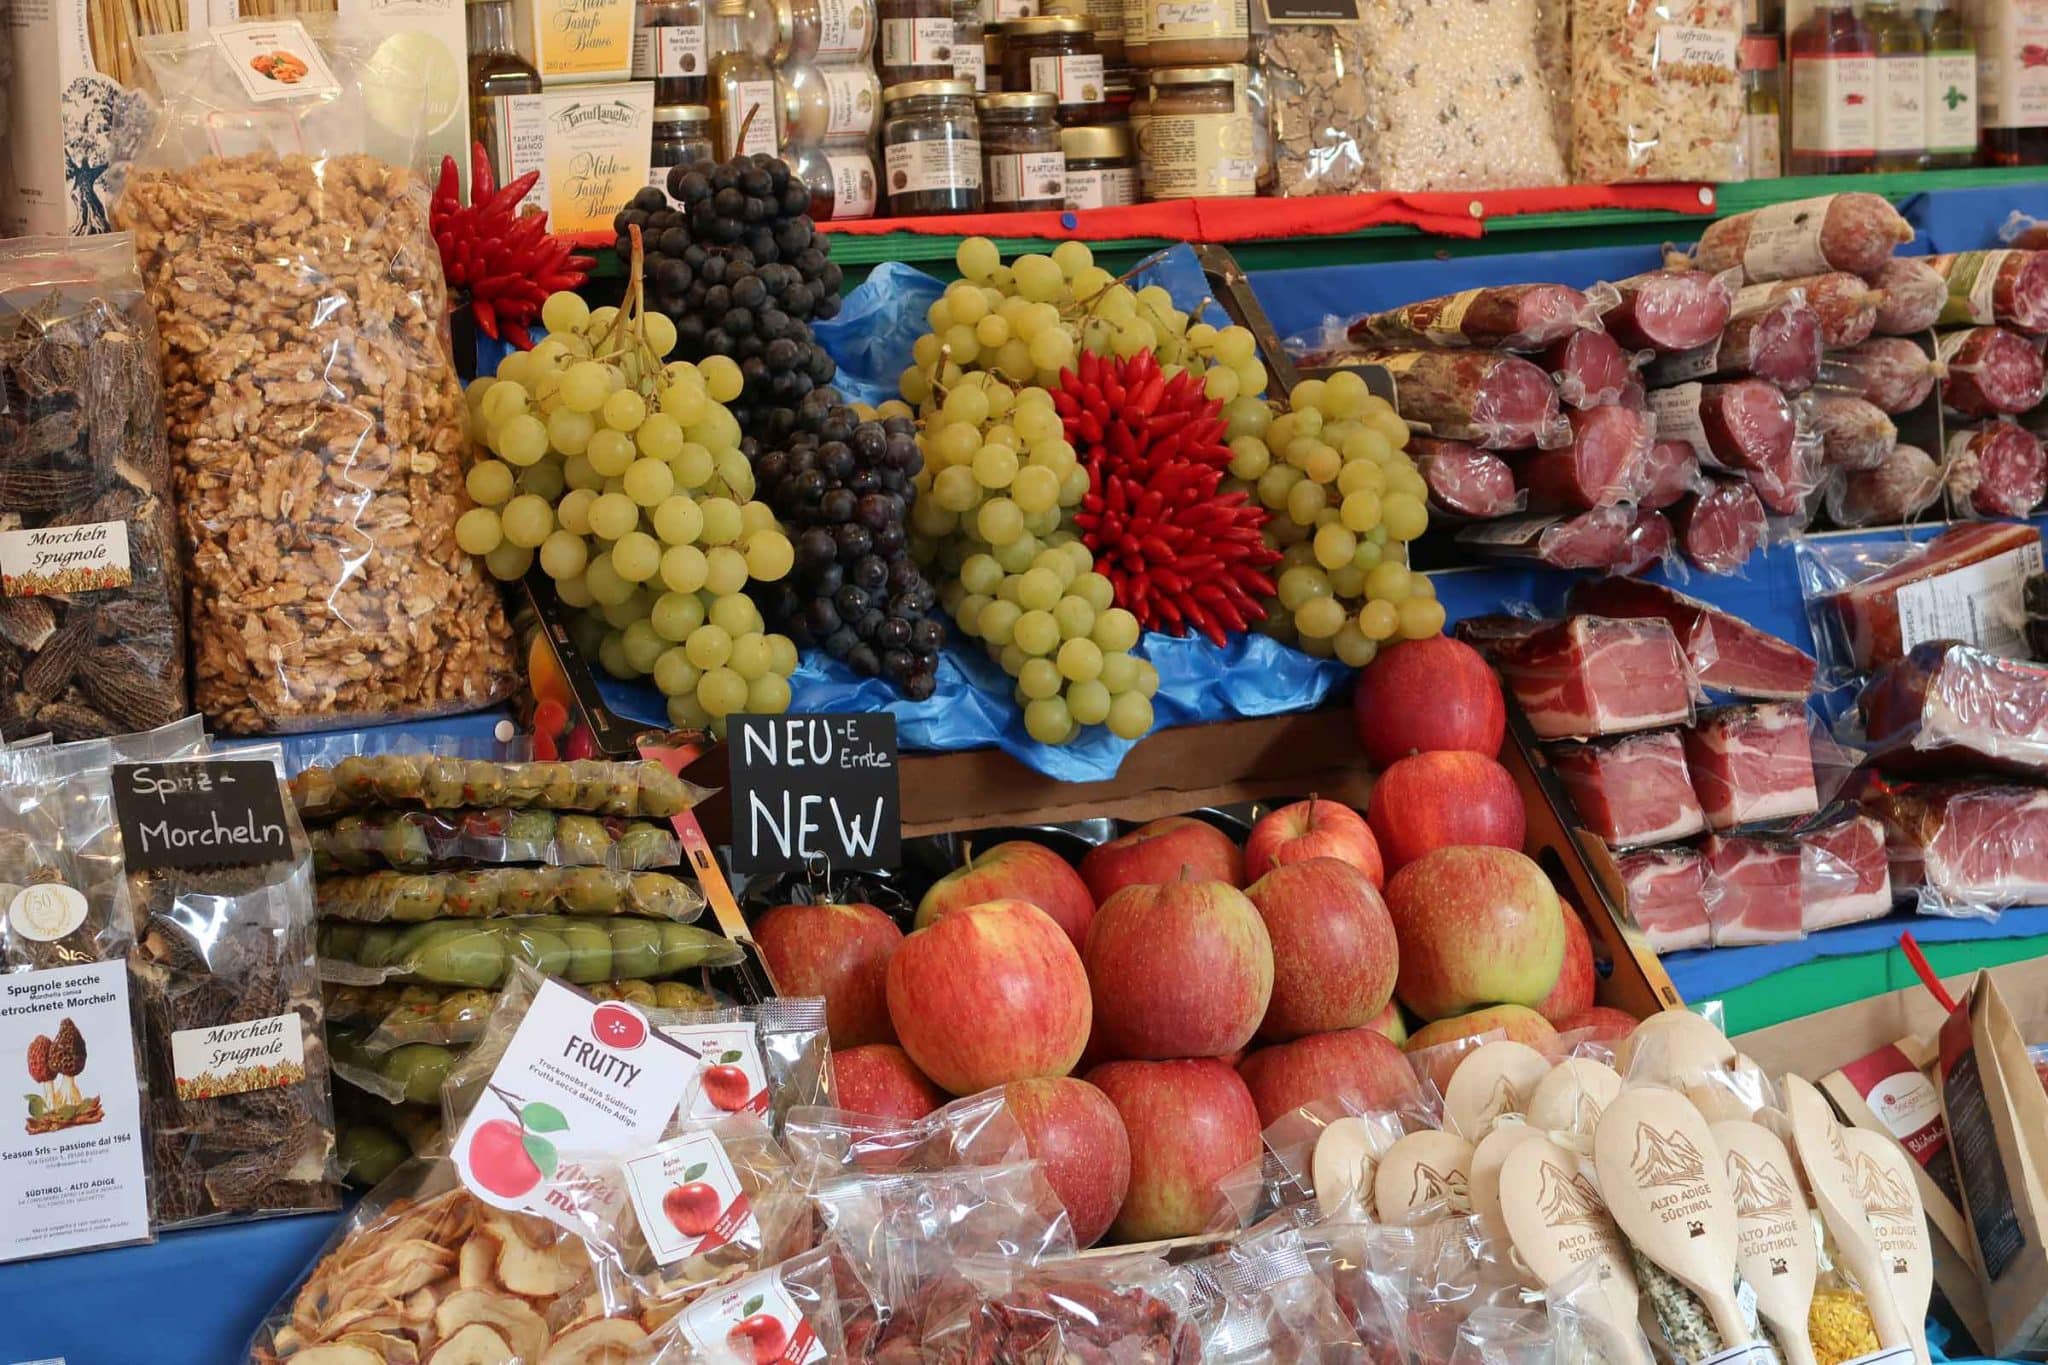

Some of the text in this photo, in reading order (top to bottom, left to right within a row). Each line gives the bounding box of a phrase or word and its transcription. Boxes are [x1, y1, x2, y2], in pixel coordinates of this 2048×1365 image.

[513, 134, 545, 143] TARTUFO
[27, 524, 107, 547] Morcheln
[32, 543, 107, 569] Spugnole
[840, 742, 892, 769] Ernte
[139, 808, 284, 853] Morcheln
[750, 789, 884, 859] NEW
[7, 975, 101, 997] Spugnole secche
[0, 992, 117, 1017] etrocknete Morcheln
[204, 1017, 284, 1046] Morcheln
[209, 1037, 284, 1069] Spugnole
[563, 1035, 642, 1088] FRUTTY
[529, 1064, 554, 1082] Frutta
[555, 1079, 578, 1096] secca
[613, 1109, 637, 1129] Adige
[538, 1058, 638, 1116] Trockenobst aus Südtirol
[2, 1149, 33, 1161] Season
[35, 1146, 50, 1156] Srls
[59, 1139, 97, 1153] passione
[98, 1136, 112, 1146] dal
[113, 1133, 131, 1144] 1964
[25, 1186, 62, 1198] SÜDTIROL
[70, 1181, 89, 1191] ALTO
[91, 1177, 115, 1188] ADIGE
[1650, 1183, 1712, 1212] ALTO ADIGE
[1660, 1199, 1712, 1224] SÜDTIROL
[1767, 1220, 1799, 1236] ADIGE
[1558, 1234, 1586, 1252] ALTO
[1744, 1235, 1799, 1257] SÜDTIROL
